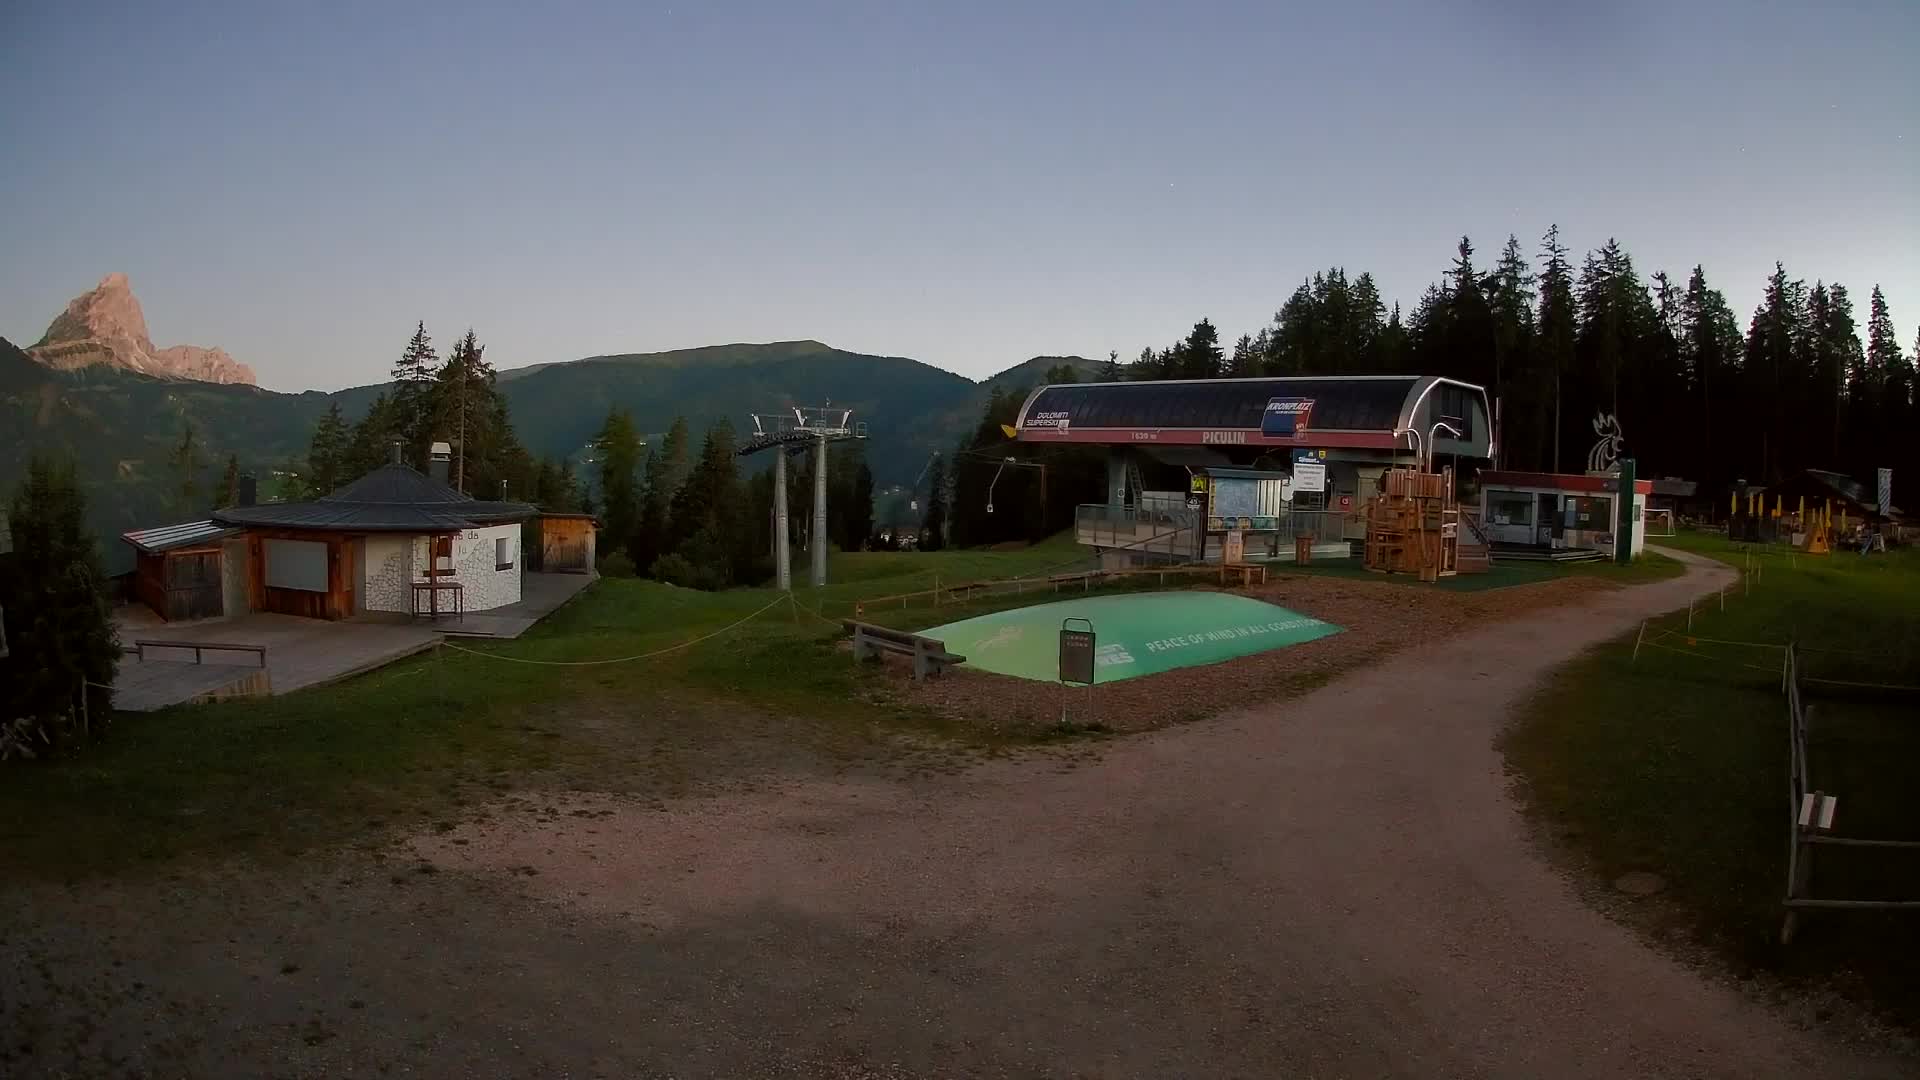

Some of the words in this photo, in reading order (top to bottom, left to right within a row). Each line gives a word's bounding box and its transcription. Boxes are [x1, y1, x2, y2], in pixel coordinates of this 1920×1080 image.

[1267, 402, 1313, 411] KRONPLATZ
[1037, 411, 1069, 419] DOLOMITI
[1202, 431, 1246, 444] PICULIN
[1145, 635, 1189, 653] PEACE
[1188, 633, 1205, 645] OF
[1206, 628, 1235, 642] MIND
[1234, 627, 1249, 638] IN
[1249, 625, 1270, 635] ALL
